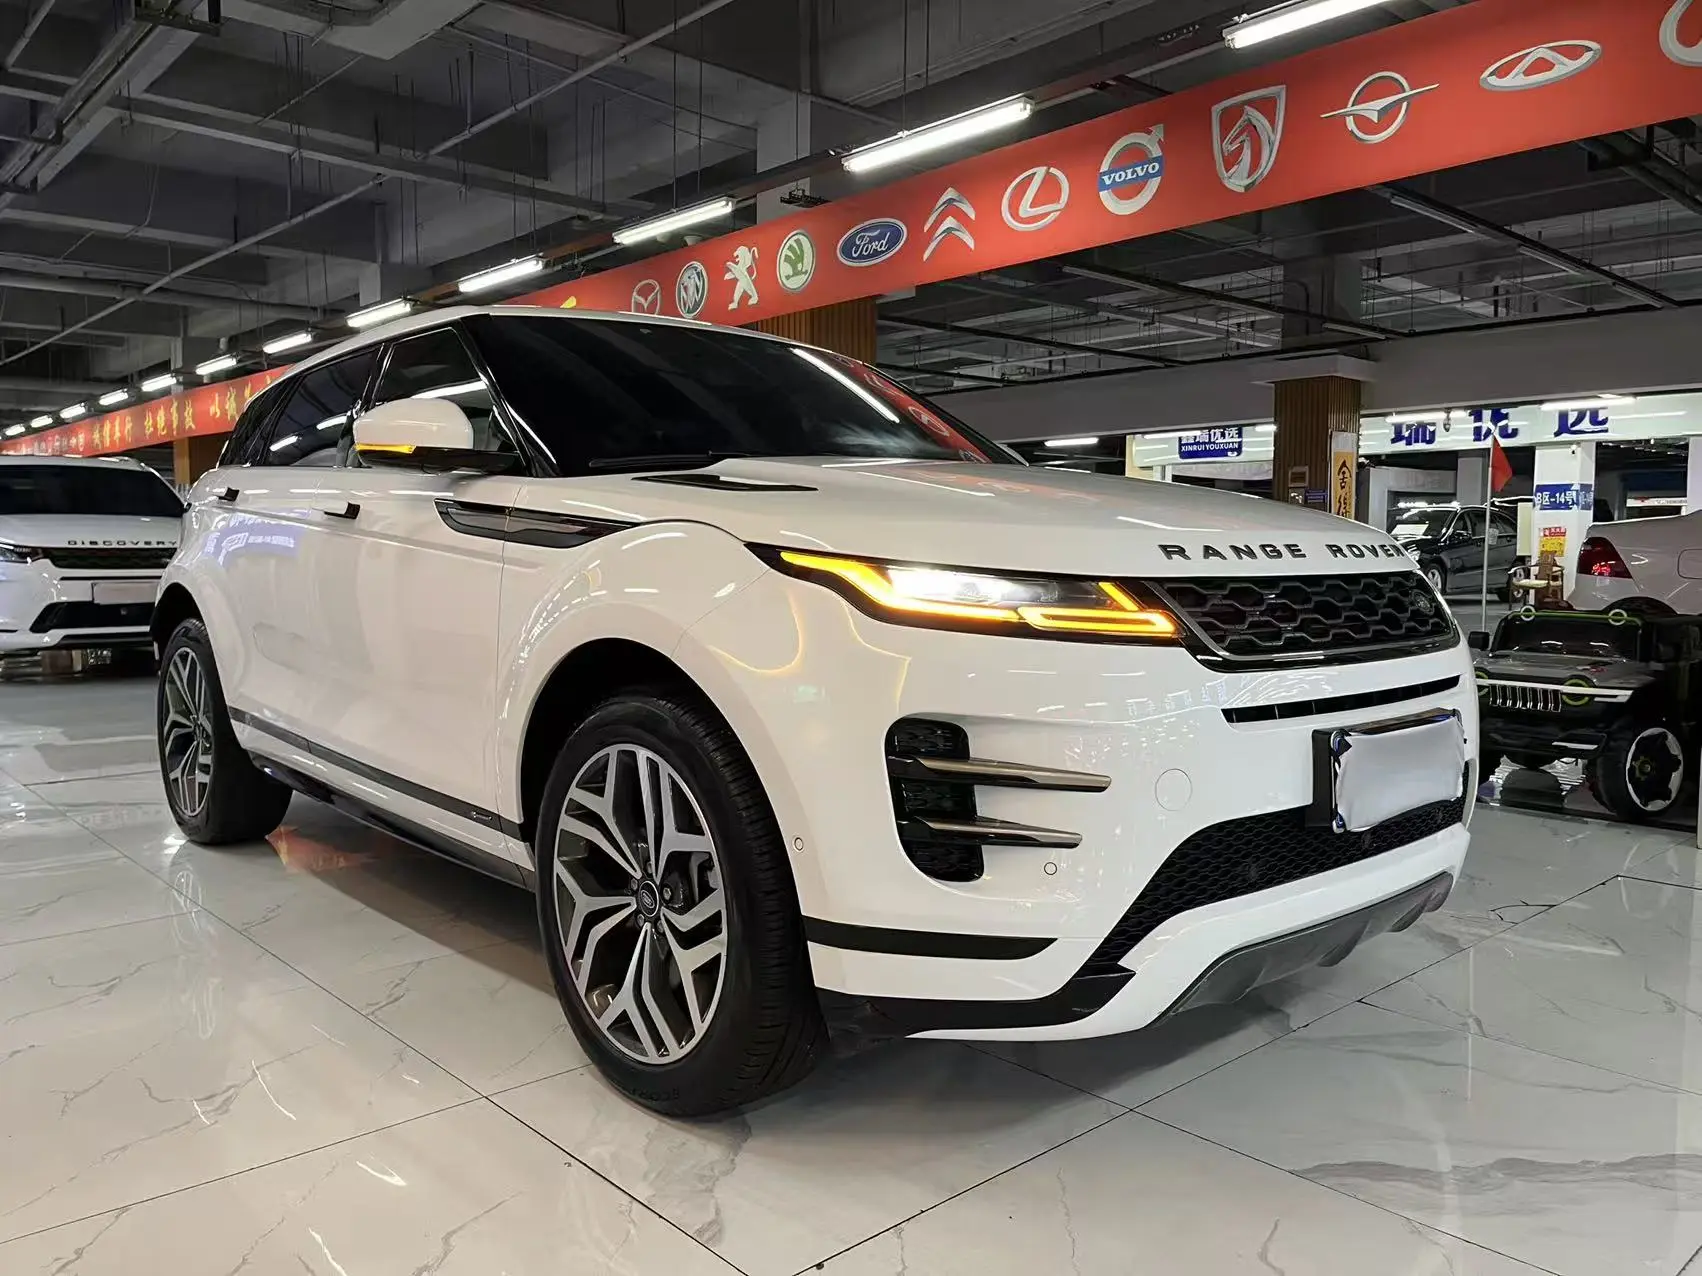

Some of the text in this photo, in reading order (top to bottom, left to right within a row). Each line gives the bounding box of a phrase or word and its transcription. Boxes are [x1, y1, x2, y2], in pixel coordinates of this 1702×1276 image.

[1101, 161, 1161, 186] VOLVO
[851, 229, 889, 257] Ford
[1158, 544, 1306, 561] RANGE
